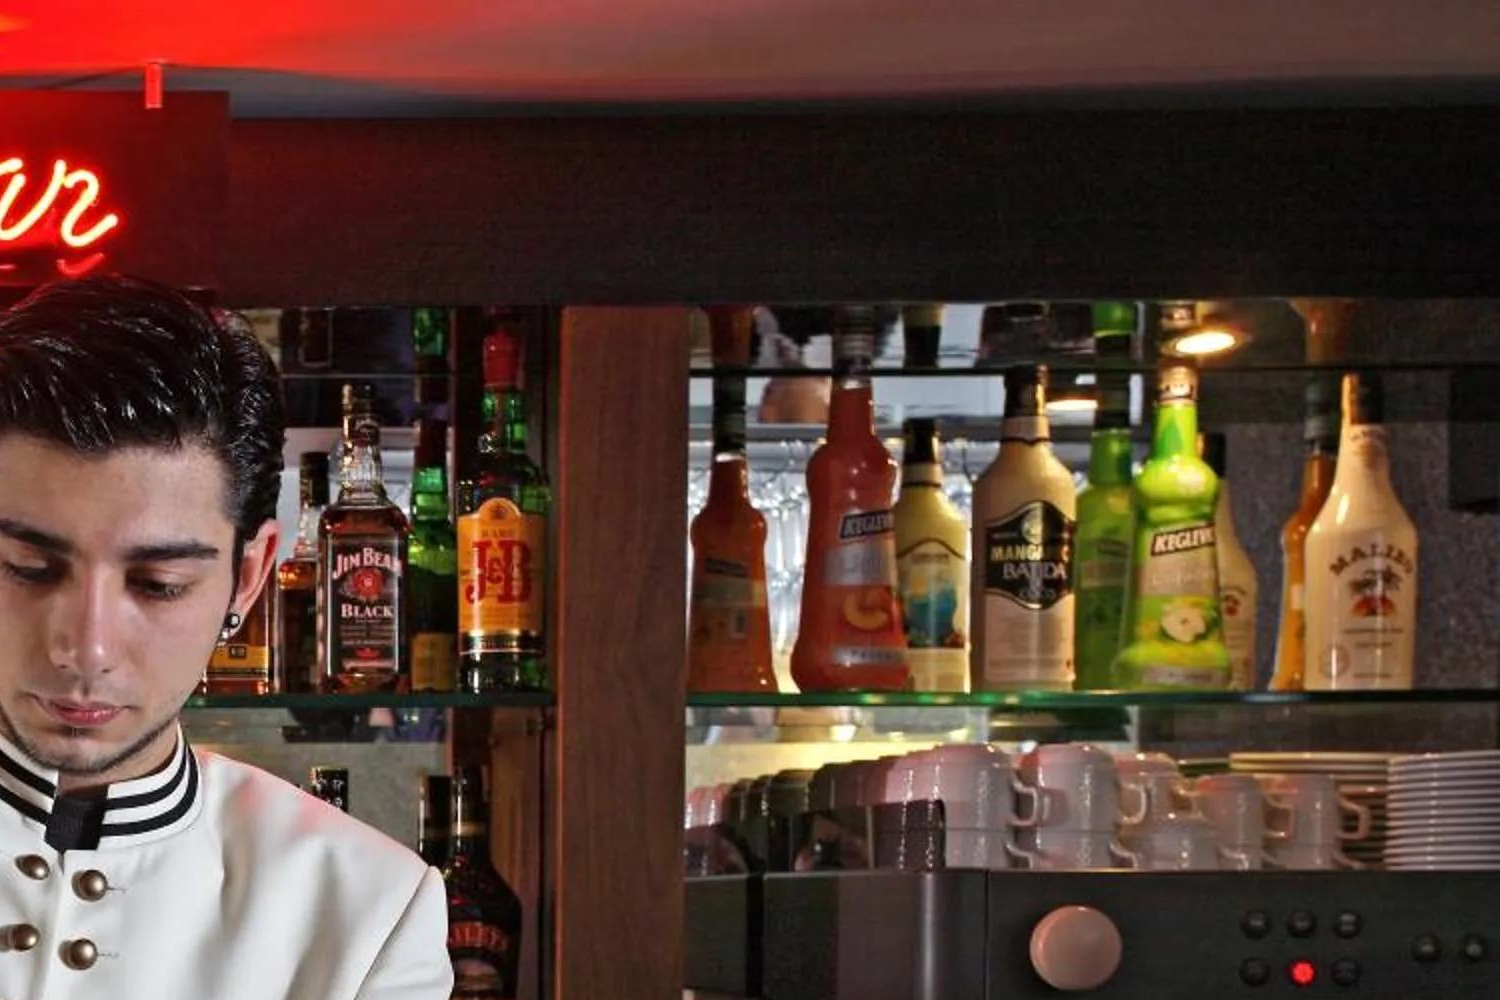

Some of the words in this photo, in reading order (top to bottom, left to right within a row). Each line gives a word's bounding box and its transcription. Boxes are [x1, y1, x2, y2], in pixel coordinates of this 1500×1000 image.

[332, 553, 362, 580] JIM
[363, 547, 403, 578] BEAM
[465, 539, 533, 604] J&B
[1003, 561, 1068, 580] BATIDA
[340, 603, 394, 619] BLACK
[450, 921, 509, 951] AILEYS
